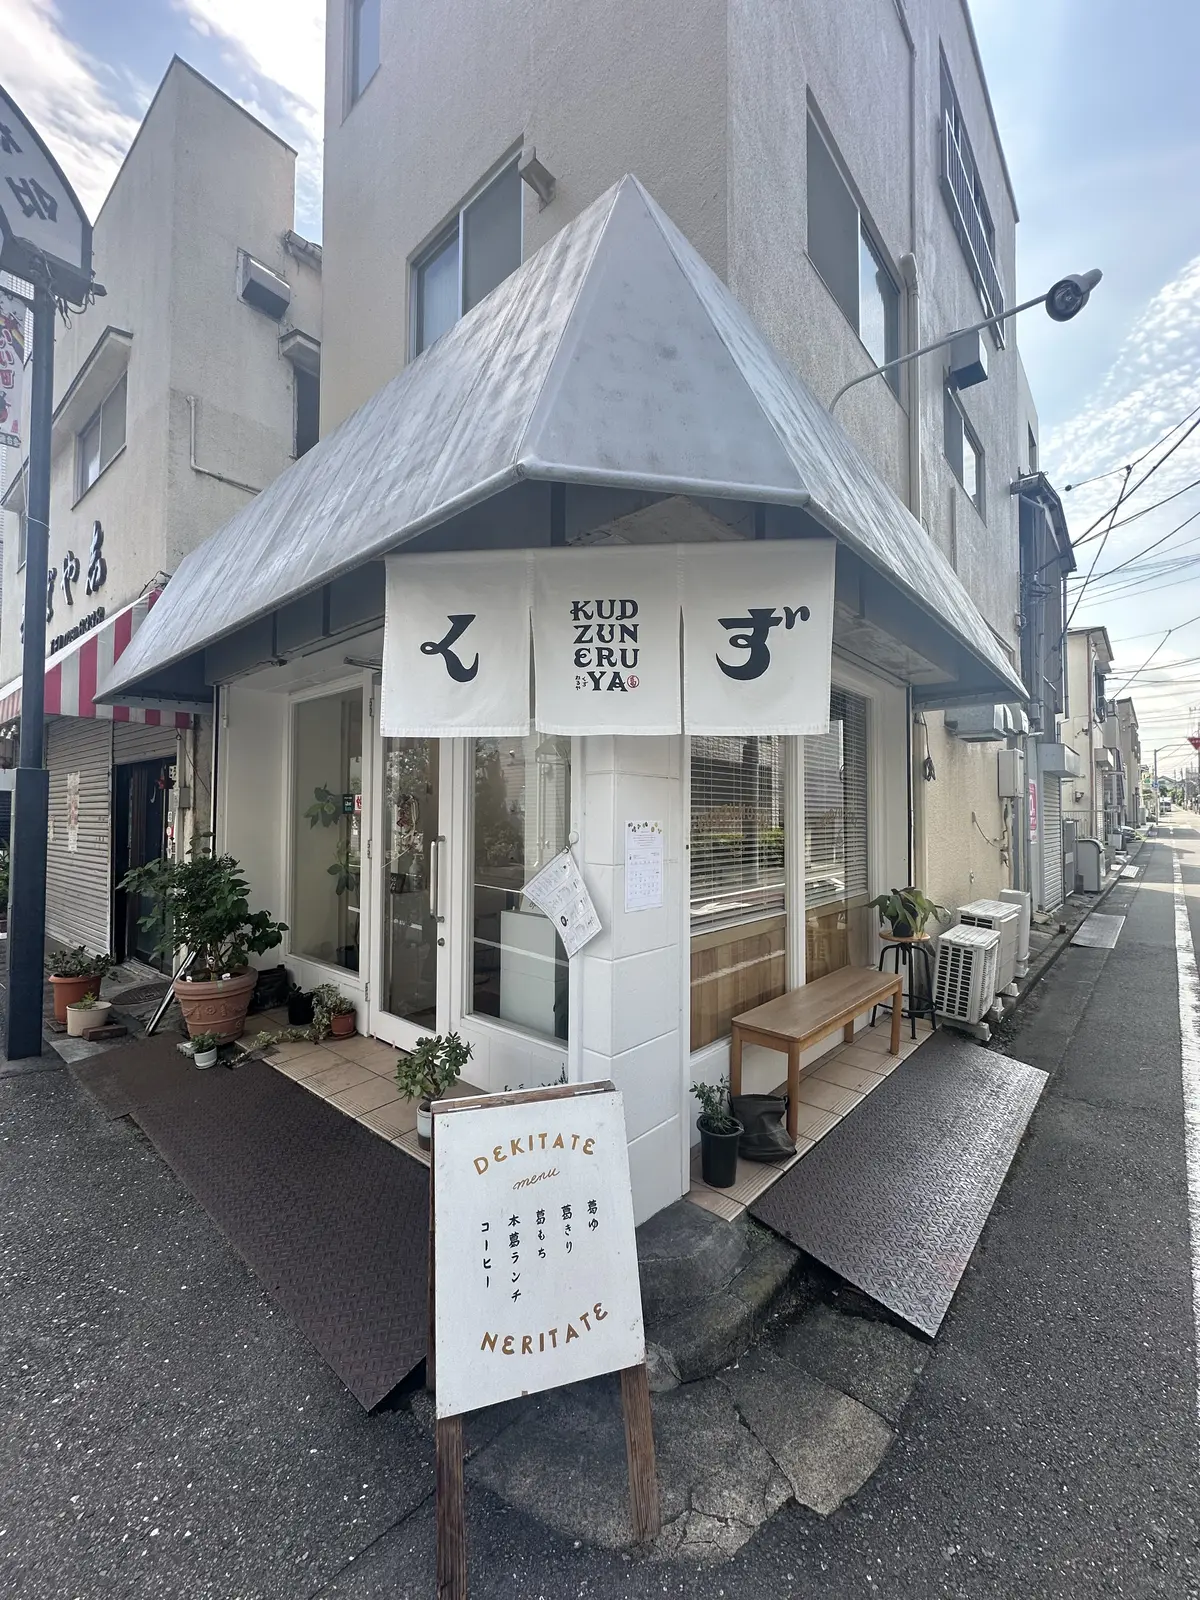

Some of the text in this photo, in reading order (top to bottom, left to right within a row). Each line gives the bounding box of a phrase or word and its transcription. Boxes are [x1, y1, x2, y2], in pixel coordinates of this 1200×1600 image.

[570, 599, 639, 621] KUD
[420, 614, 479, 683] く
[573, 624, 639, 644] ZUN
[574, 647, 639, 668] ERU
[716, 605, 811, 681] ず
[587, 671, 628, 692] YA
[473, 1132, 596, 1176] DEKITATE
[512, 1167, 561, 1190] menu
[536, 1208, 547, 1259] 葛もち
[561, 1204, 573, 1254] 葛きり
[587, 1199, 599, 1232] 葛ゆ
[481, 1222, 492, 1289] コーヒー
[508, 1214, 521, 1303] 本葛ランチ
[480, 1302, 608, 1356] NERITATE
